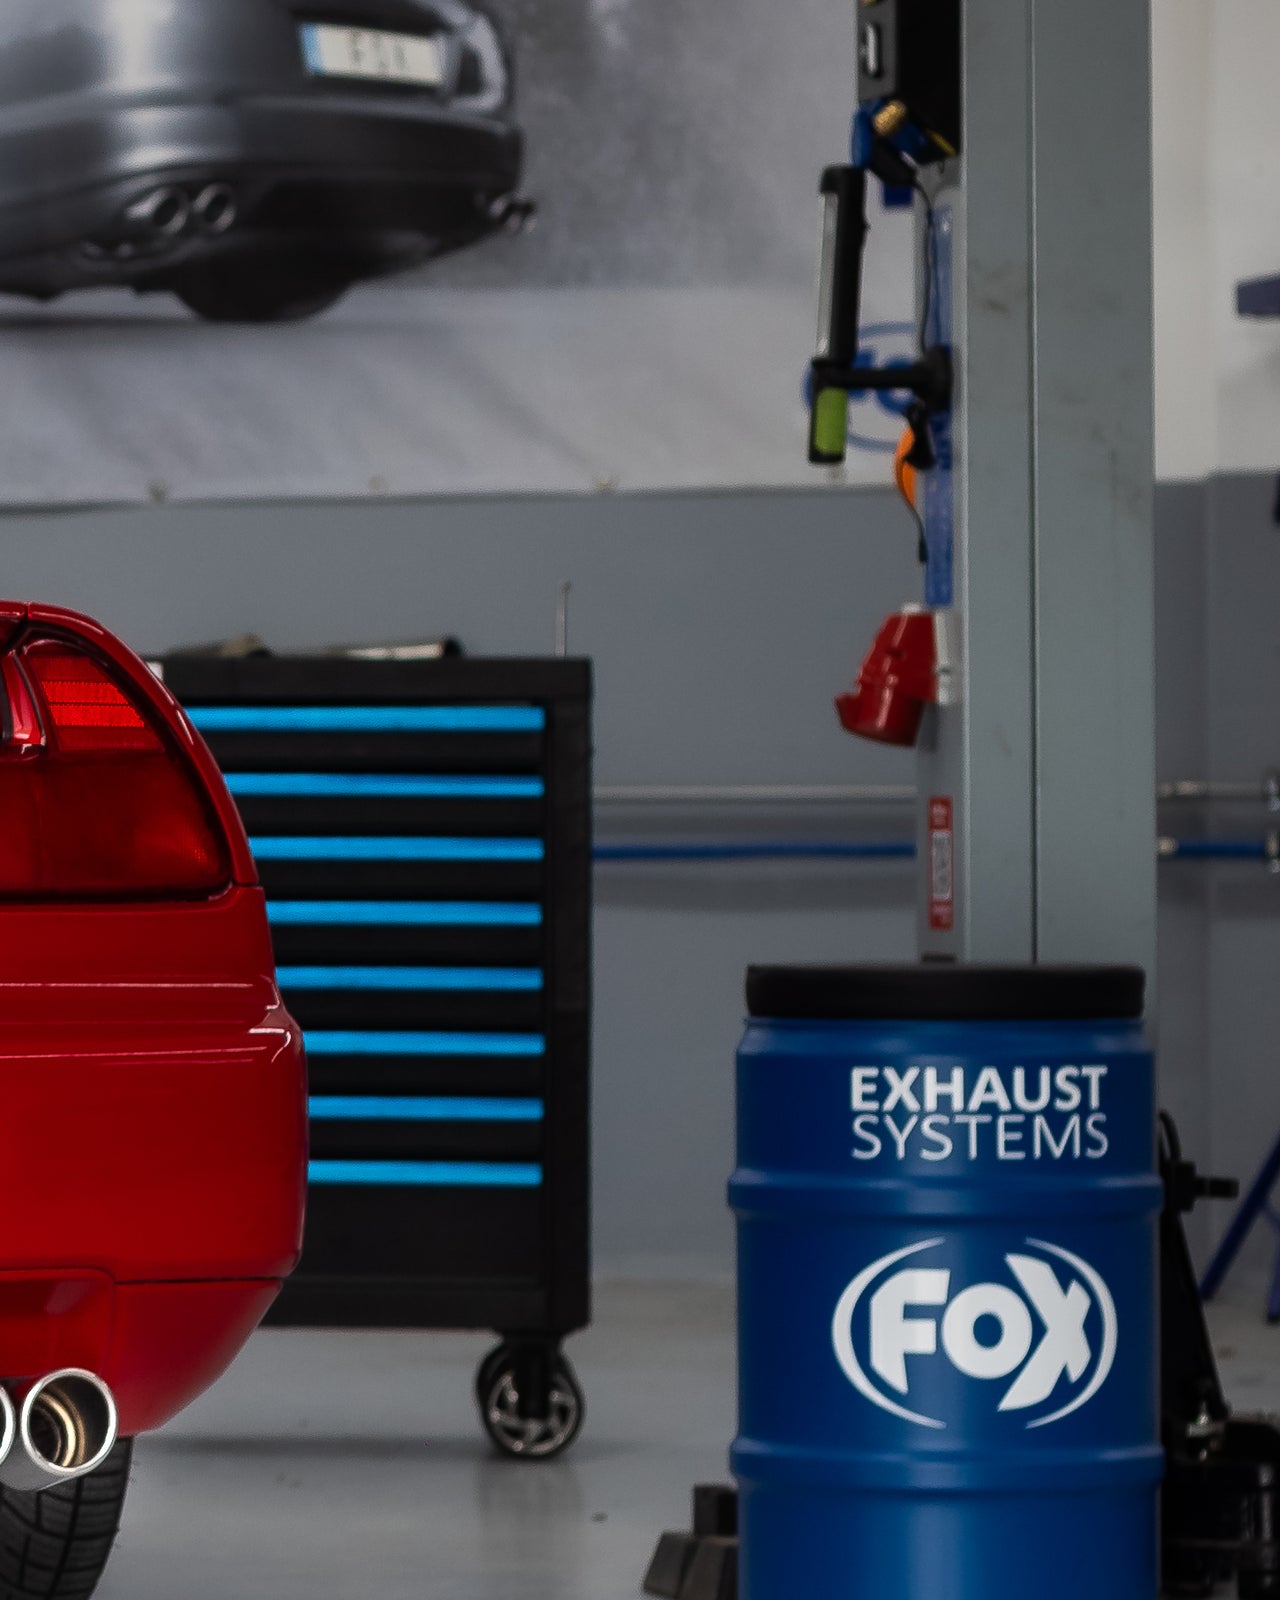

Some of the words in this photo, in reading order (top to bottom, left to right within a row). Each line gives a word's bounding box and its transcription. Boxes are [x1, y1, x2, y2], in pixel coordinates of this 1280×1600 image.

[850, 1065, 1108, 1112] EXHAUST
[851, 1113, 1109, 1161] SYSTEMS
[869, 1253, 1093, 1412] FOX
